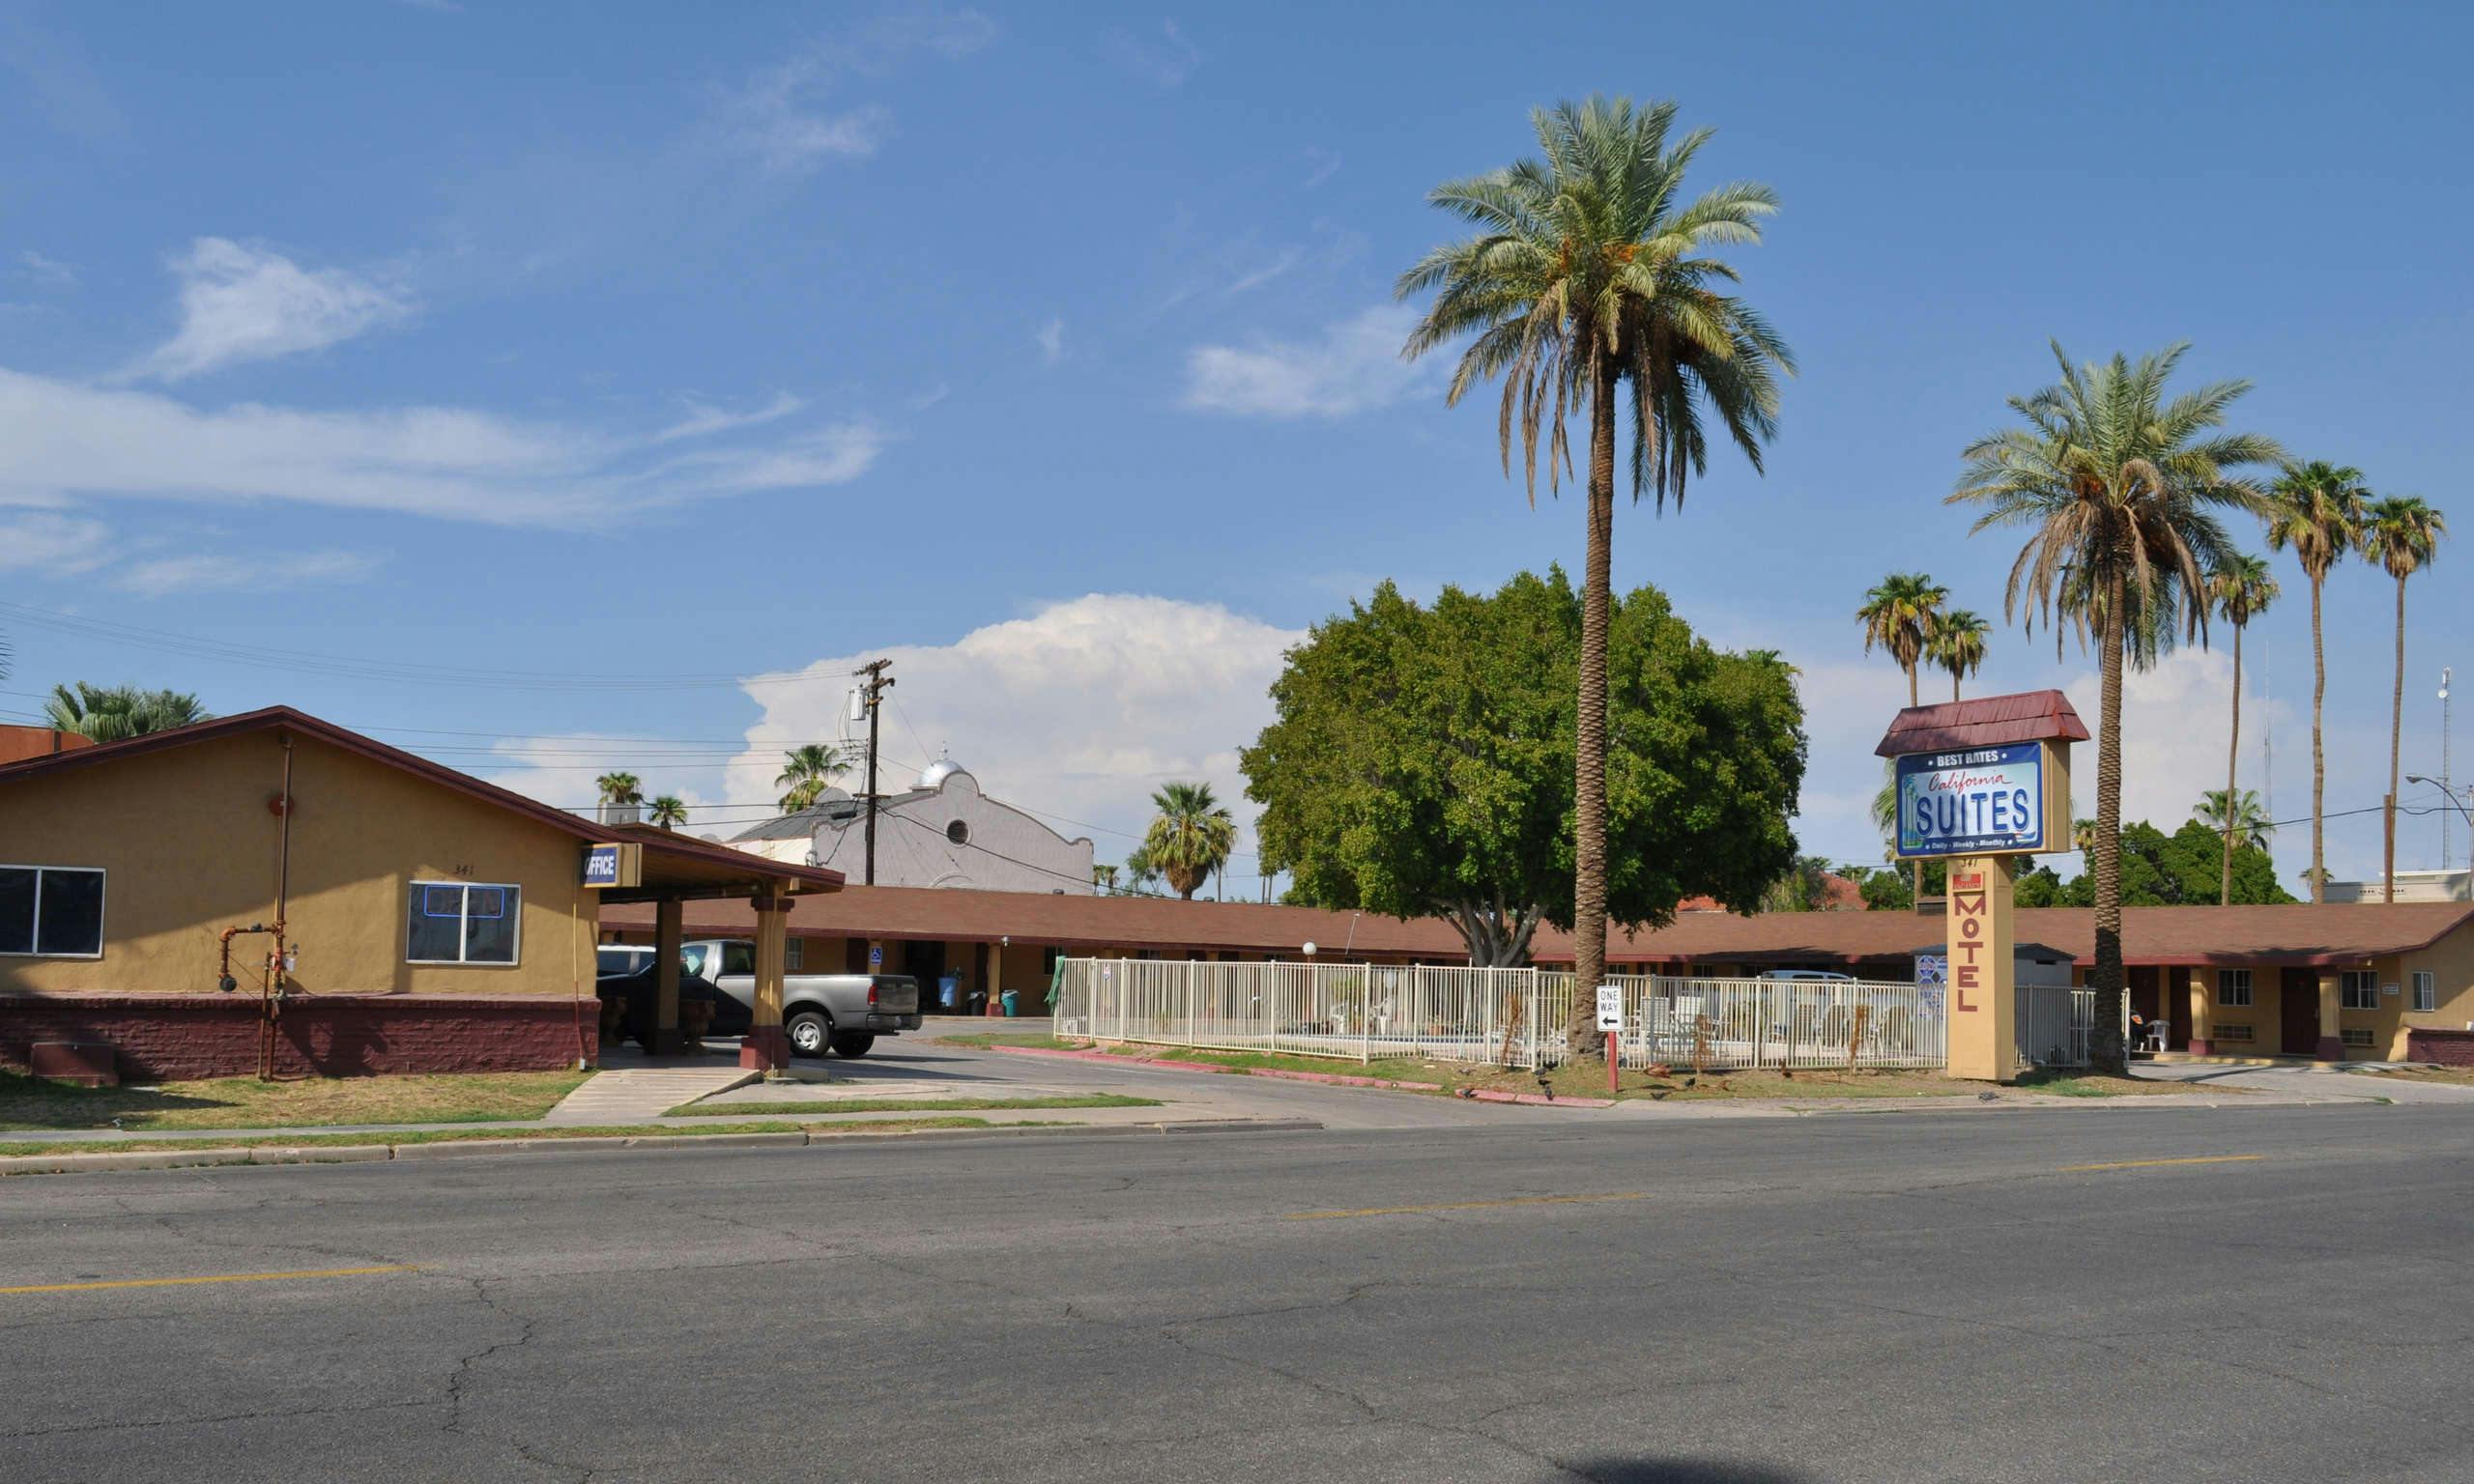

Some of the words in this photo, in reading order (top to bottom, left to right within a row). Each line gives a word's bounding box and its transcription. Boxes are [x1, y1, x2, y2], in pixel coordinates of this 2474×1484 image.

[1937, 755, 1963, 766] BEST
[1966, 751, 1999, 763] RATES
[1928, 771, 2012, 794] California
[1916, 788, 2029, 837] SUITES
[1952, 841, 1975, 849] Weekly
[455, 864, 475, 875] 341
[585, 856, 614, 875] OFFICE
[1962, 858, 1977, 868] 341
[1955, 895, 1986, 1012] MOTEL
[1600, 990, 1618, 1000] ONE
[1600, 1002, 1618, 1012] WAY
